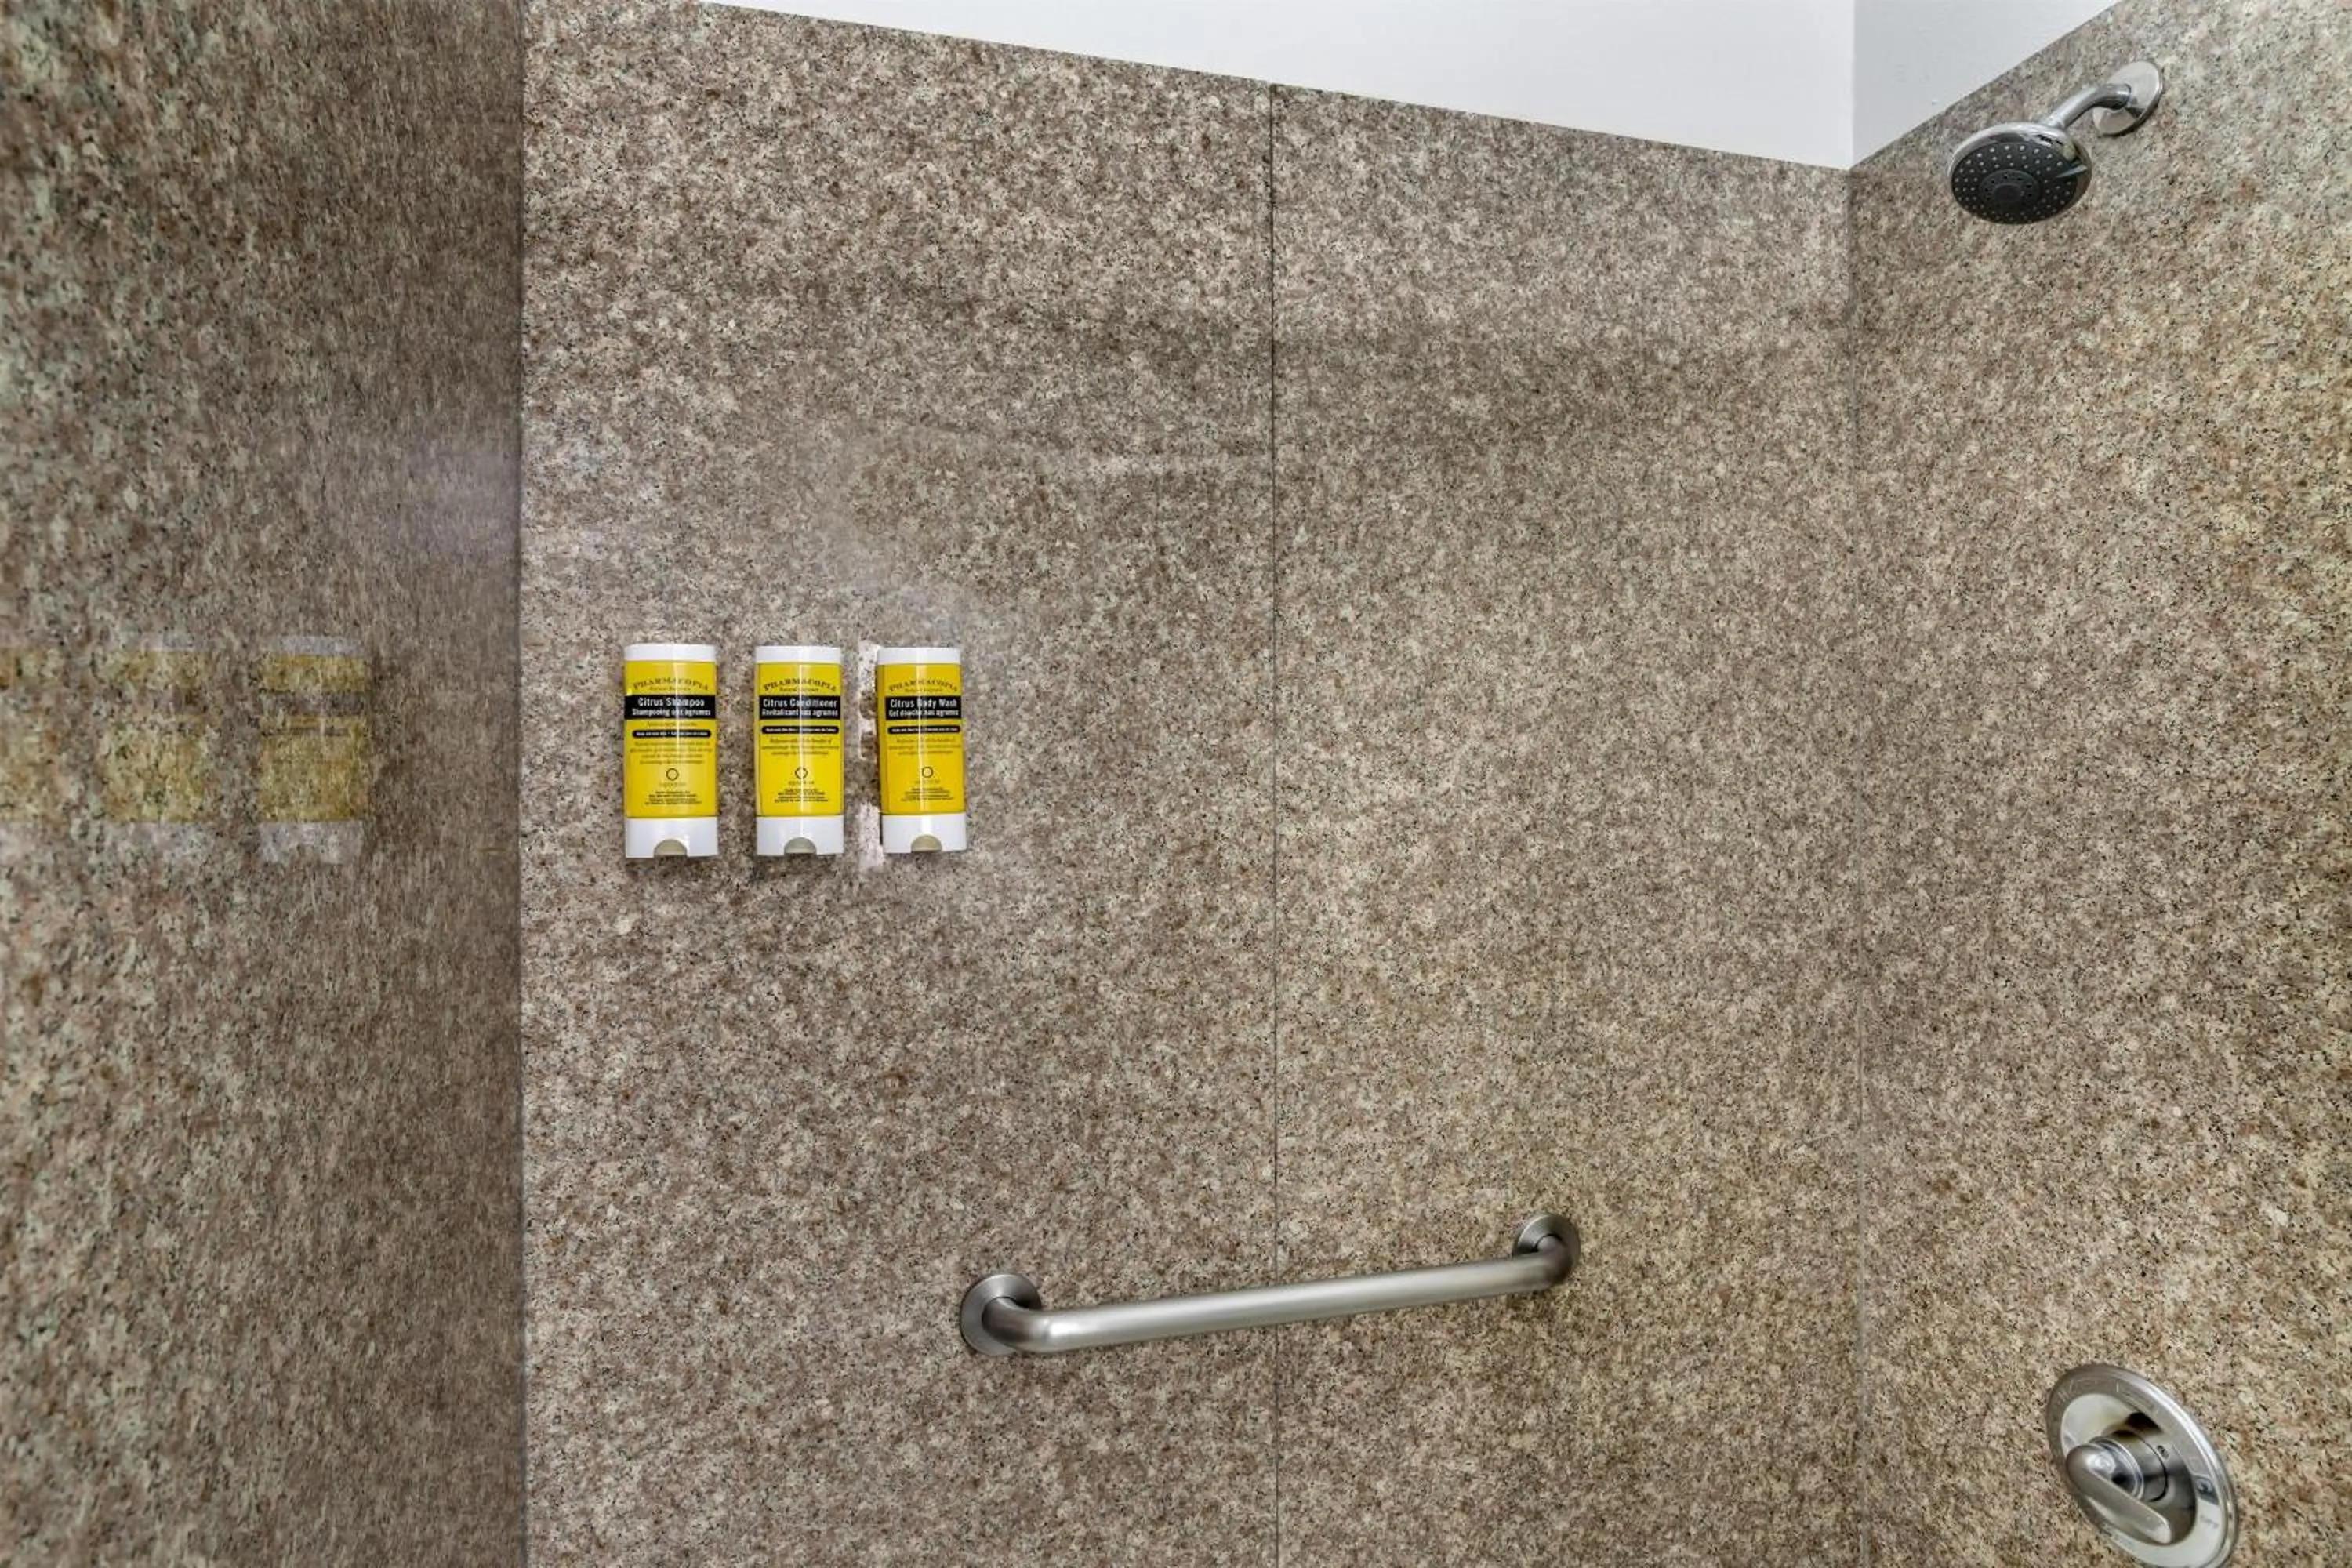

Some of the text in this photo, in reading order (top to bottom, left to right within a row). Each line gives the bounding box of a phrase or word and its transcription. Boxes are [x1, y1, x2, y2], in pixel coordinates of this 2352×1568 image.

[637, 697, 705, 708] Citrus Shampoo
[763, 699, 837, 707] Citrus Conditioner
[890, 698, 957, 709] Citrus Body Wash
